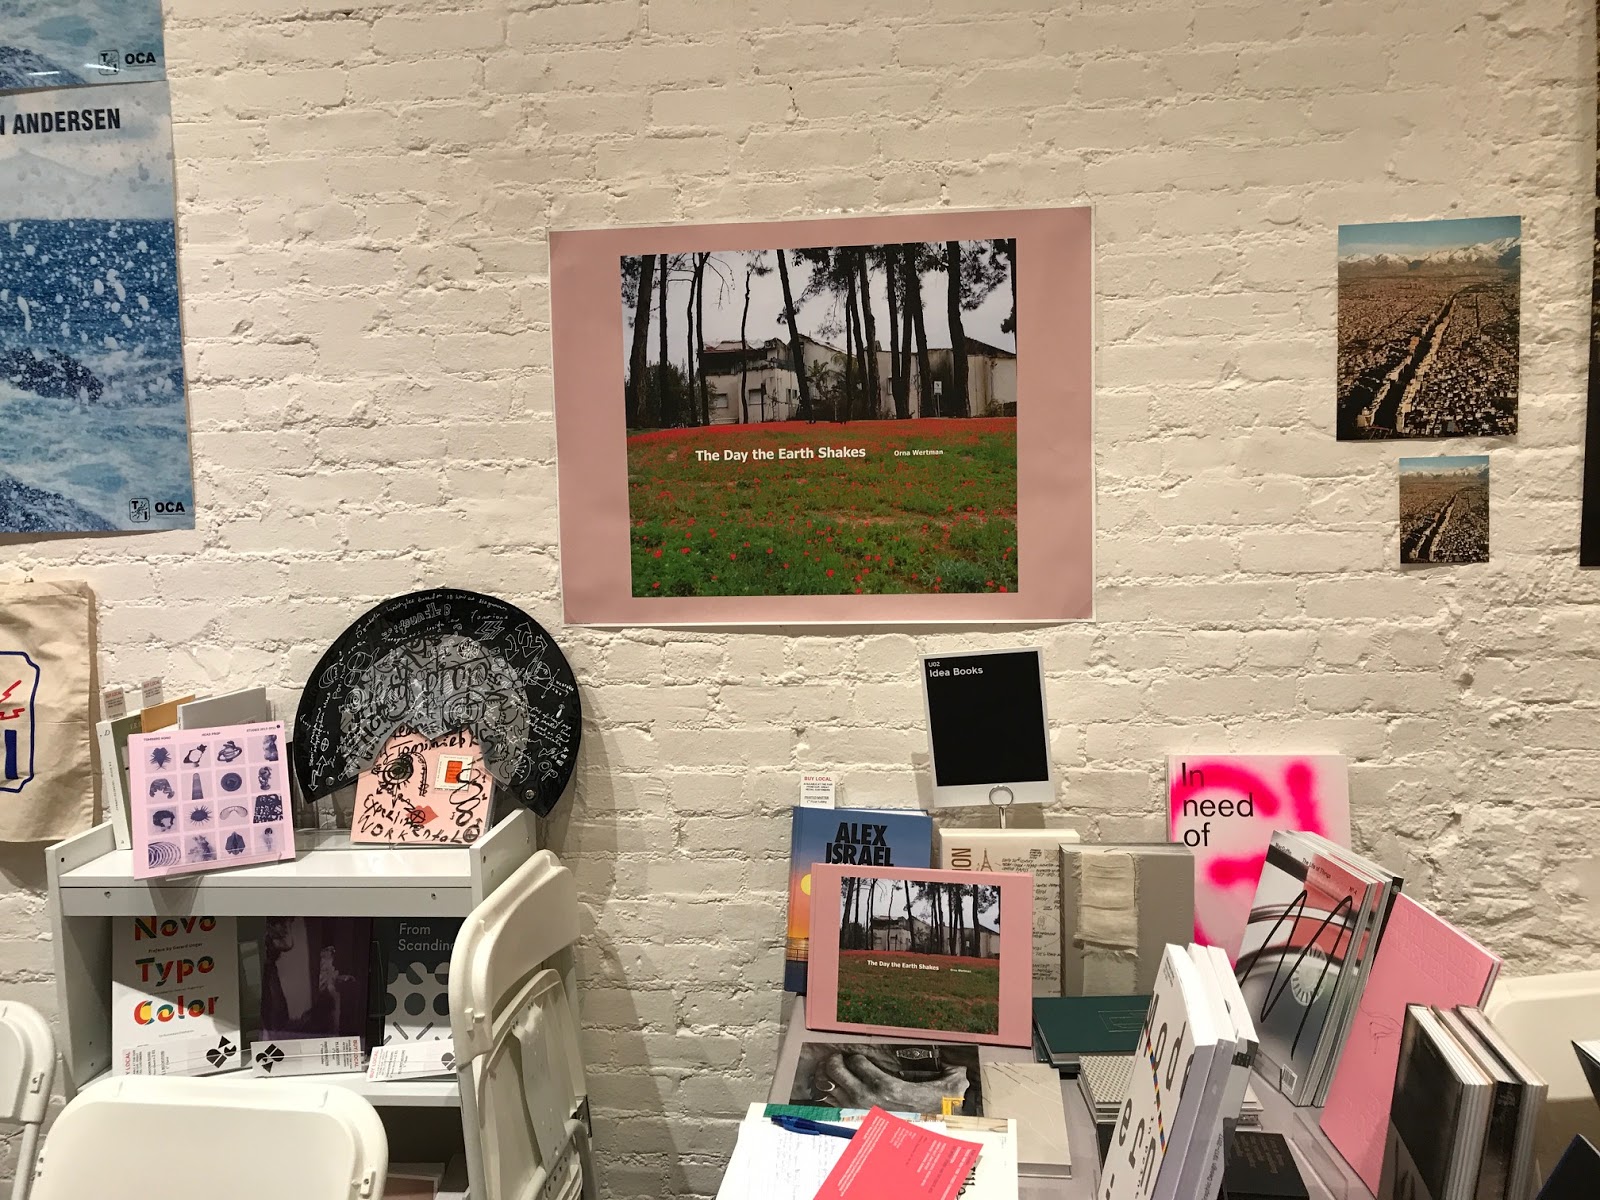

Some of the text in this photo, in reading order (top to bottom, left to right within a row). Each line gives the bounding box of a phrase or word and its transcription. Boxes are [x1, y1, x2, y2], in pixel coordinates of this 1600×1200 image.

[125, 52, 156, 64] OCA
[12, 108, 121, 135] ANDERSEN
[695, 446, 866, 463] The Day the Earth Shakes
[912, 449, 944, 457] Wertman
[154, 501, 186, 513] OCA
[929, 666, 984, 678] Idea Books
[1181, 762, 1205, 788] In
[1183, 792, 1254, 817] need
[834, 822, 888, 847] ALEX
[1183, 822, 1211, 847] of
[825, 842, 895, 867] ISRAEL
[134, 915, 217, 941] Novo
[399, 922, 431, 935] From
[134, 955, 215, 988] Typo
[866, 959, 940, 971] The Day the Earth Shakes
[133, 994, 220, 1026] Color
